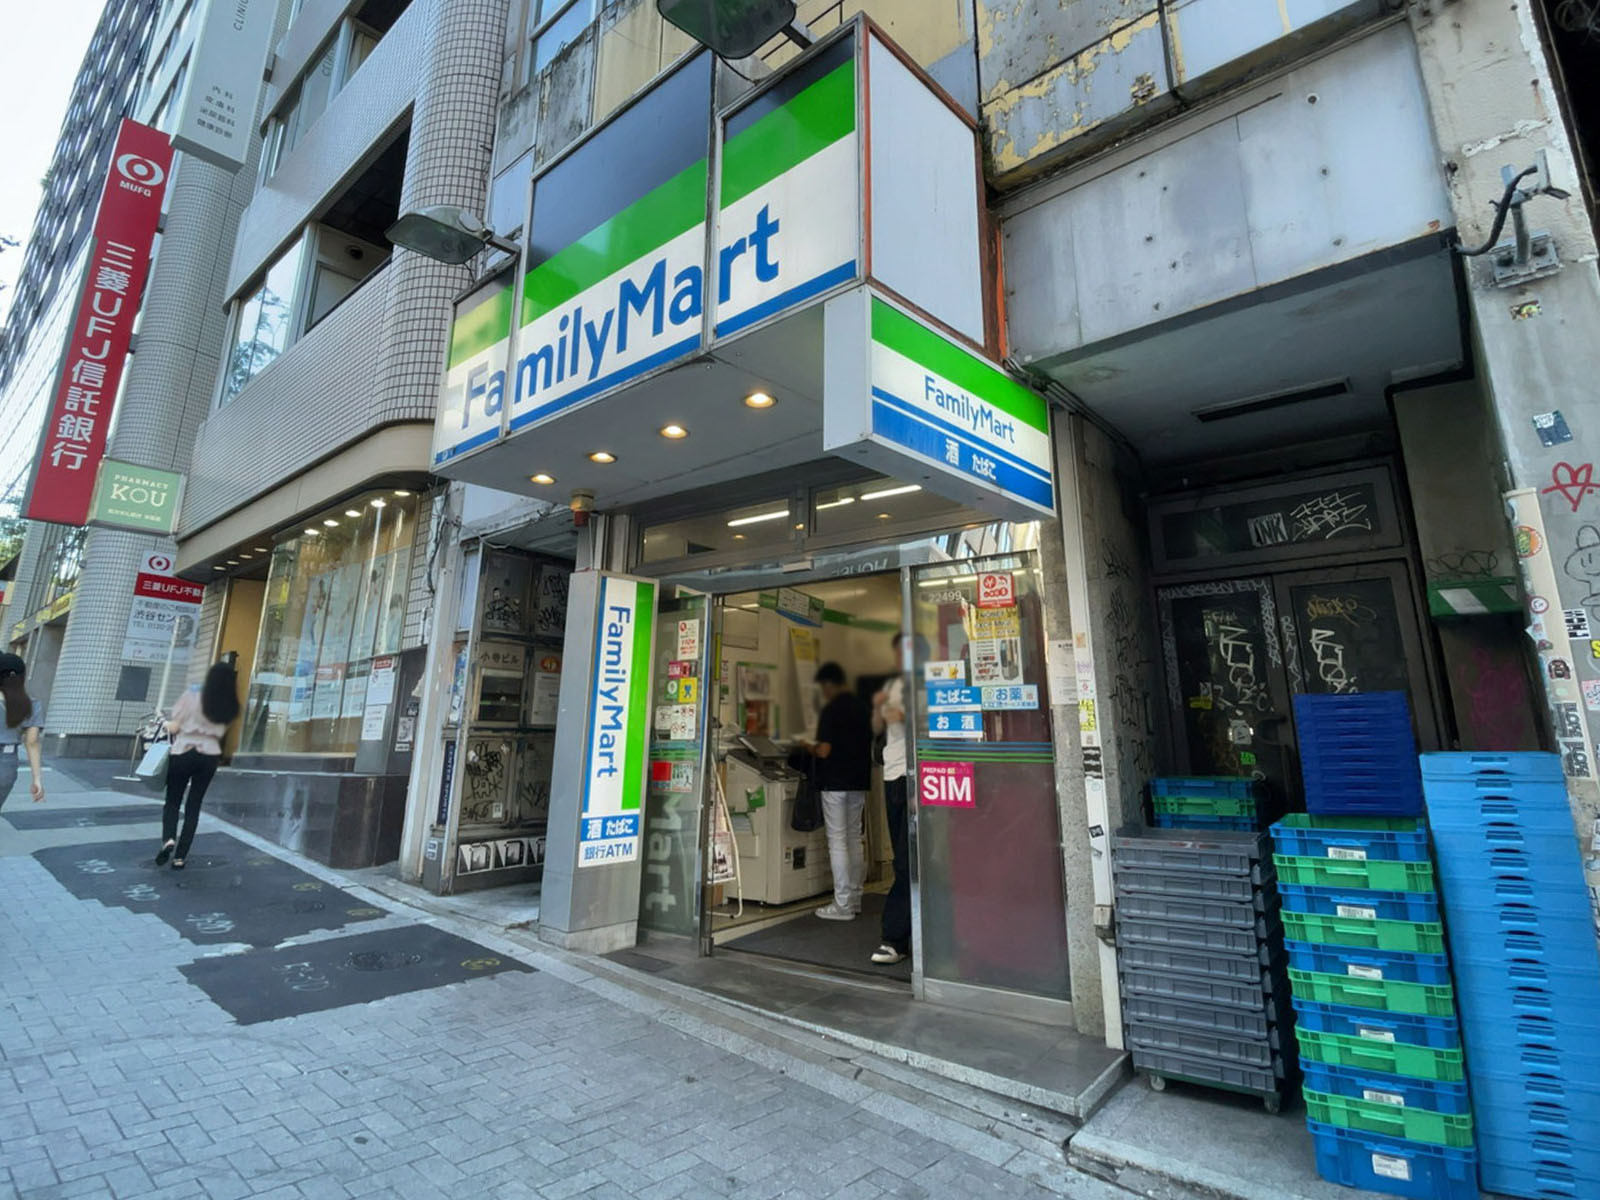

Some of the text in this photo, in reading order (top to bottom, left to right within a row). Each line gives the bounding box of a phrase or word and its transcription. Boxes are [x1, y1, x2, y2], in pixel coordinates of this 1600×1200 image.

[120, 180, 152, 197] MUFG
[461, 204, 780, 430] FamilyMart
[51, 240, 136, 470] 三菱UFJ信託銀行
[925, 375, 1015, 444] FamilyMart
[945, 437, 997, 480] 酒 たばこ
[114, 474, 168, 489] PHARMACY
[110, 483, 167, 507] KOU
[142, 581, 204, 597] 三菱UFJ不動
[597, 606, 631, 777] FamilyMart
[935, 689, 972, 704] たばこ
[995, 687, 1022, 701] お薬
[923, 775, 972, 802] SIM
[586, 816, 634, 840] 酒 たばこ
[584, 842, 633, 861] 銀行ATM
